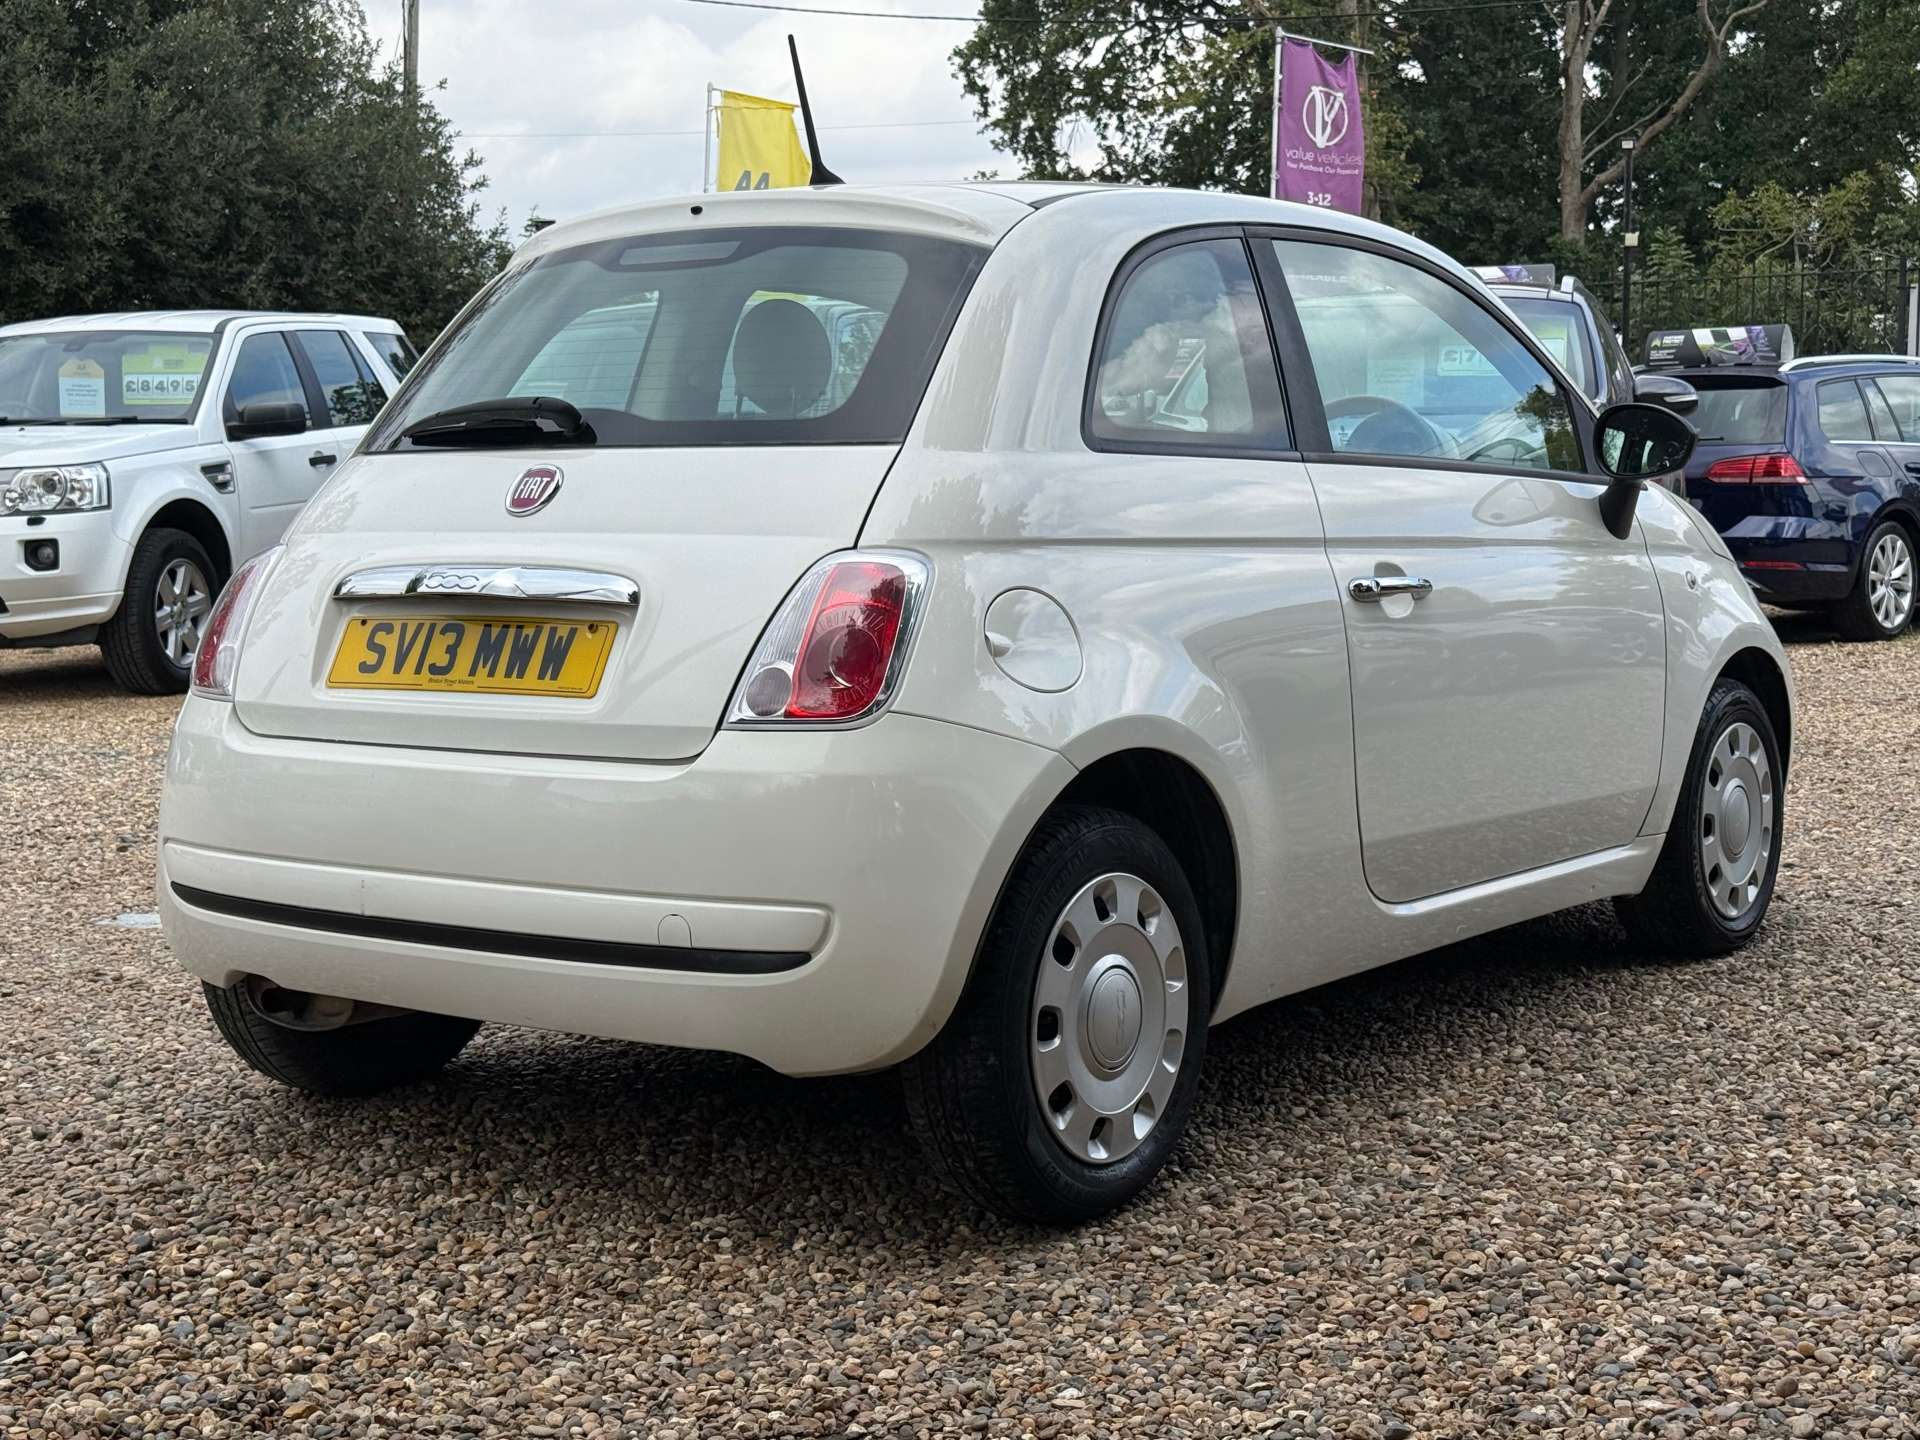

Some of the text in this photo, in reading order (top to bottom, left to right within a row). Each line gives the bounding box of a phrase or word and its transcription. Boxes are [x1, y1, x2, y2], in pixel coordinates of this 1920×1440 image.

[1285, 147, 1362, 166] value vehicles
[734, 170, 769, 191] AA
[1443, 349, 1479, 362] £7
[125, 380, 195, 392] £8495
[515, 477, 551, 500] FIAT
[425, 573, 480, 589] 500
[358, 622, 578, 681] SV13 MWW
